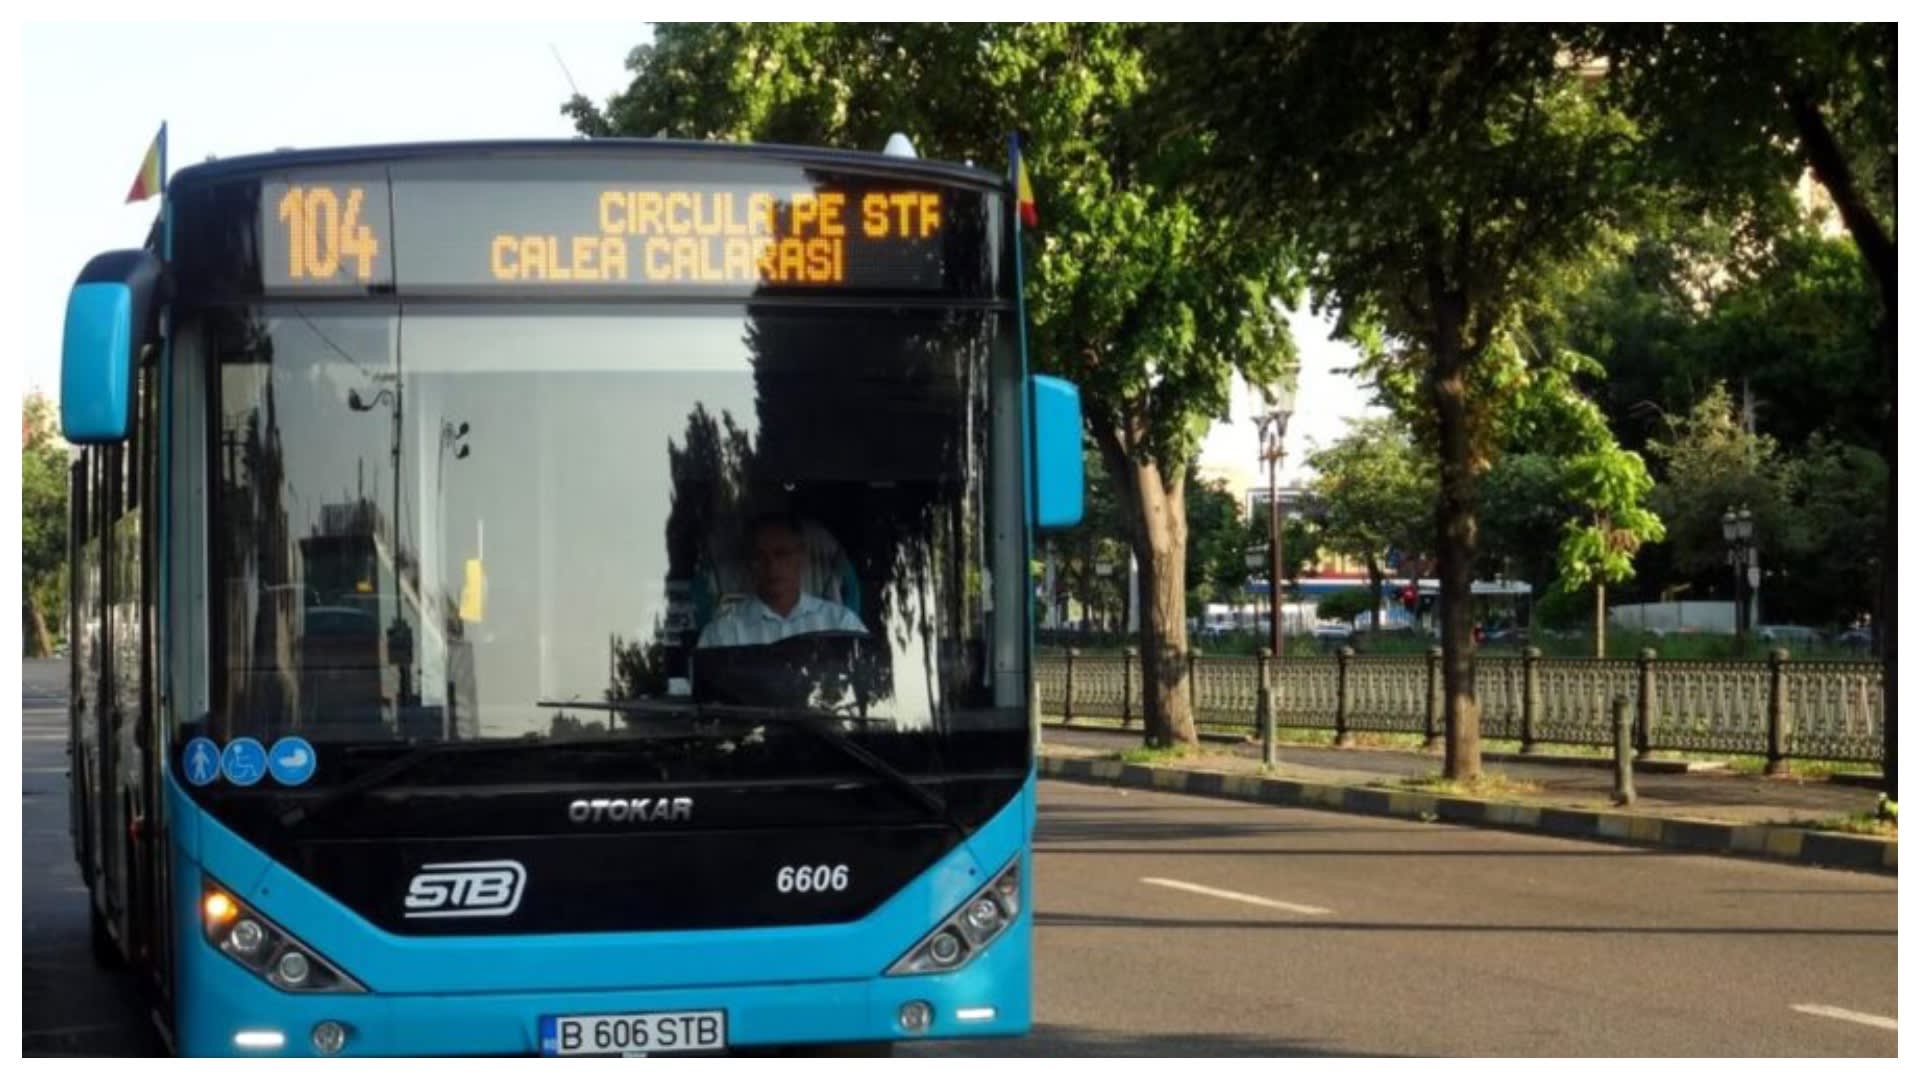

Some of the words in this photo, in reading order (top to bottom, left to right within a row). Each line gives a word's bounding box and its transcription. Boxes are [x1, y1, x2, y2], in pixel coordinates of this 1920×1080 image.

[279, 186, 378, 281] 104
[600, 191, 774, 236] CIRCULA
[791, 192, 845, 236] PE
[491, 236, 627, 281] CALEA
[645, 238, 844, 281] CALARASI
[568, 797, 693, 823] OTOKAR
[404, 868, 516, 909] STB
[776, 864, 849, 893] 6606
[561, 1020, 583, 1050] B
[594, 1018, 650, 1048] 606
[656, 1016, 718, 1046] STB
